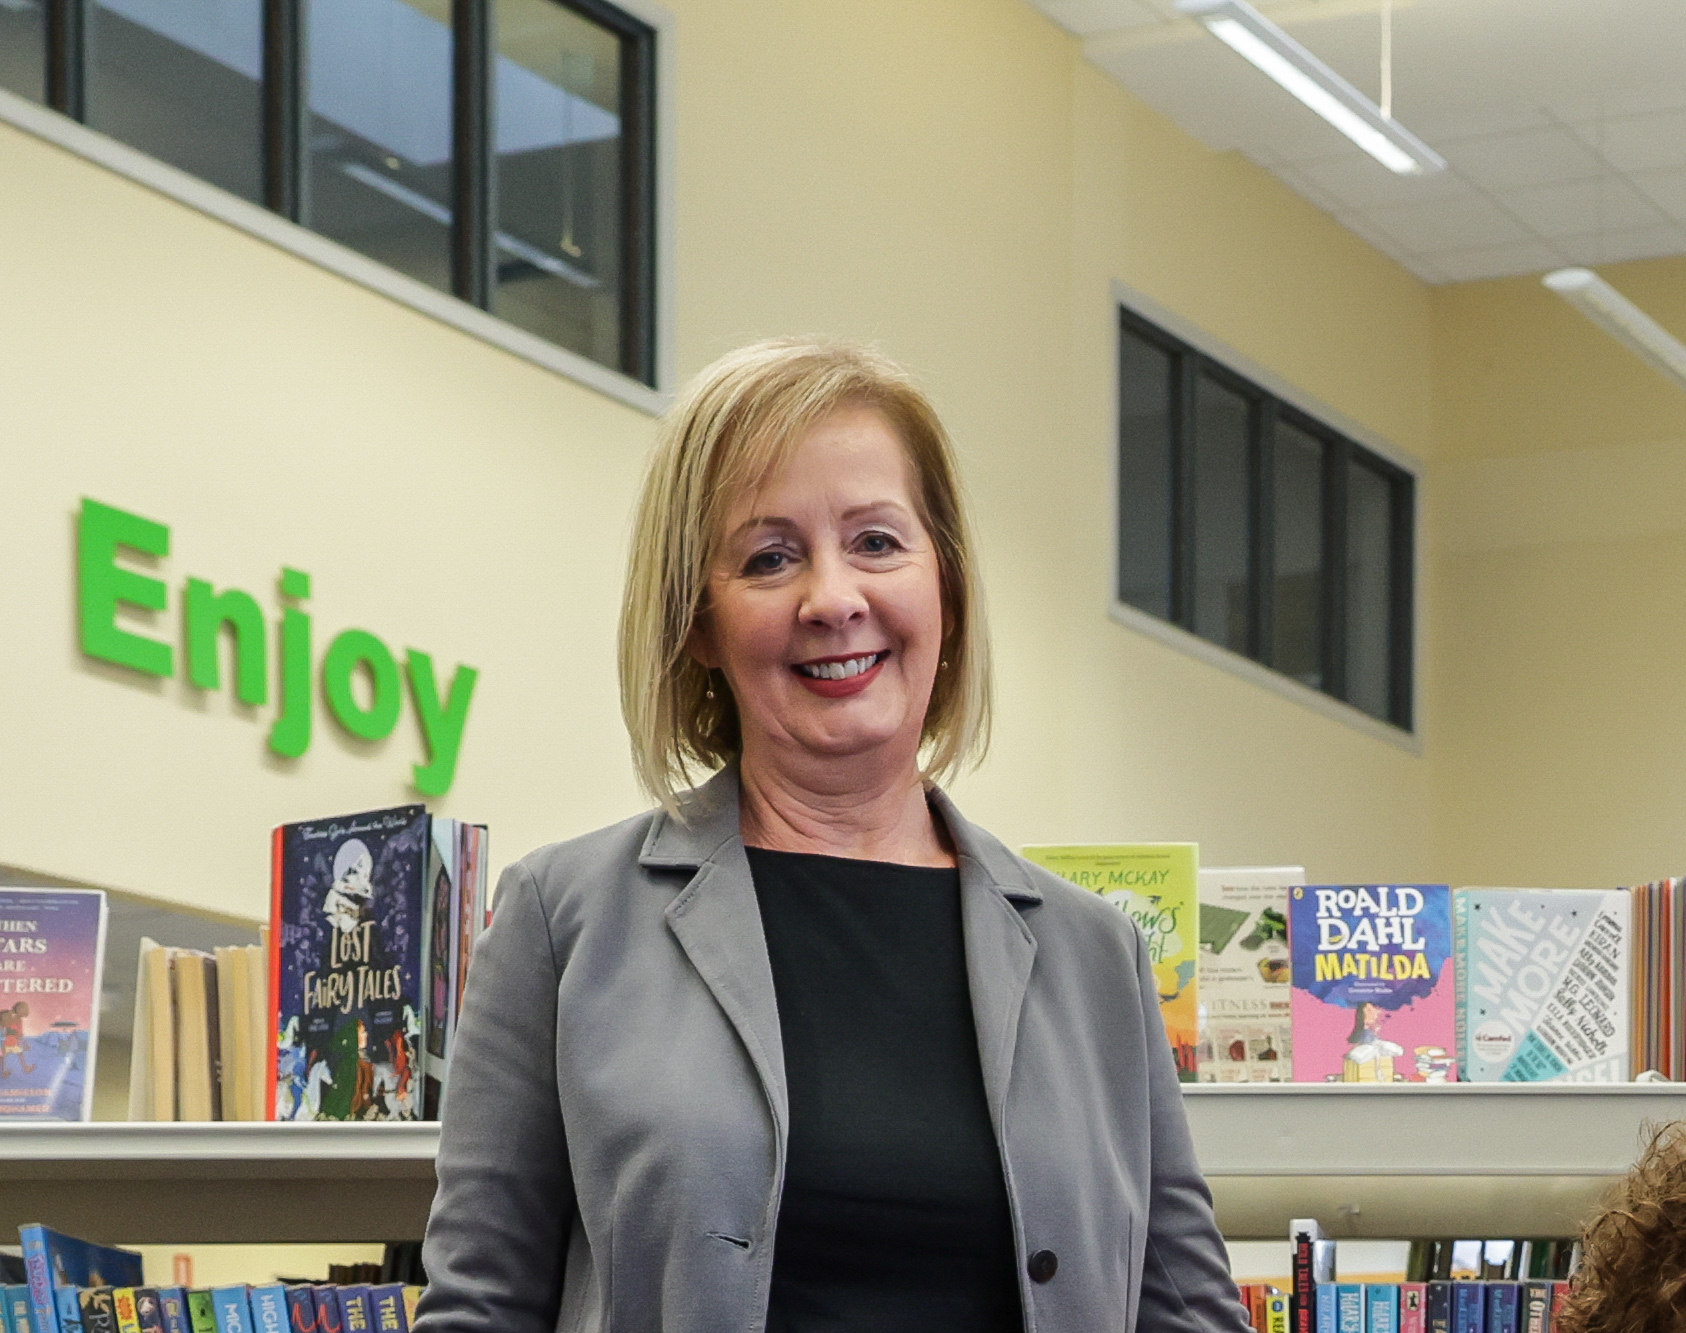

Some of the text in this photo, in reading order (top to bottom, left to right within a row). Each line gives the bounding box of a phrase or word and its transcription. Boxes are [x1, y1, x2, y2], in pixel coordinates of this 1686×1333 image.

[79, 497, 479, 797] Enjoy
[1315, 886, 1424, 918] ROALD
[330, 920, 376, 969] LOST
[1316, 916, 1426, 951] DAHL
[1314, 952, 1431, 982] MATILDA
[1473, 899, 1546, 1005] MAKE
[356, 965, 401, 1009] TALES
[1501, 914, 1582, 1034] MORE
[223, 1304, 241, 1333] MIC
[346, 1297, 365, 1331] THE
[379, 1296, 396, 1331] THE
